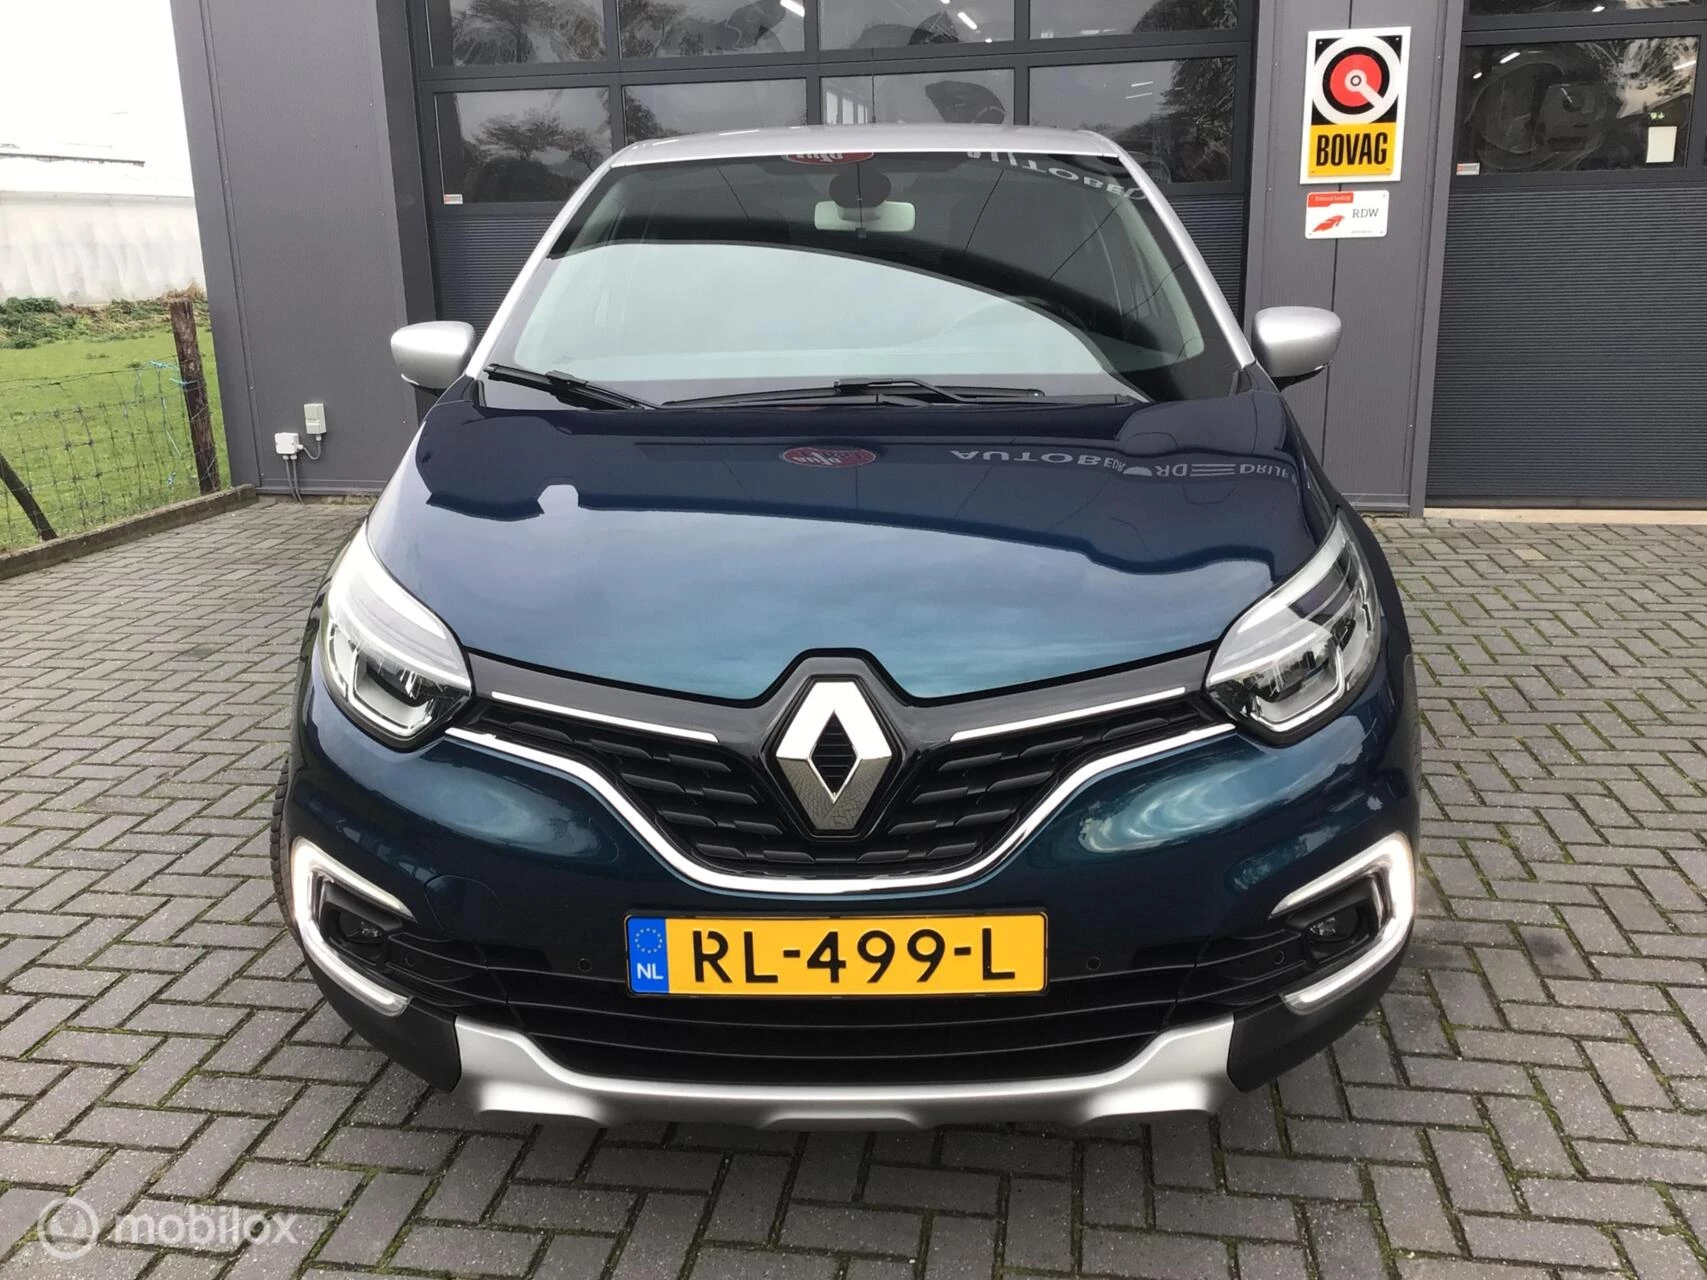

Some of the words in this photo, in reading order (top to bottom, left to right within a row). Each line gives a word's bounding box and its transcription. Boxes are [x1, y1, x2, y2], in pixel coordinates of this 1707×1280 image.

[1316, 132, 1388, 167] BOVAG
[1352, 207, 1379, 218] RDW
[636, 962, 664, 980] NL
[692, 928, 1016, 984] RL-499-L
